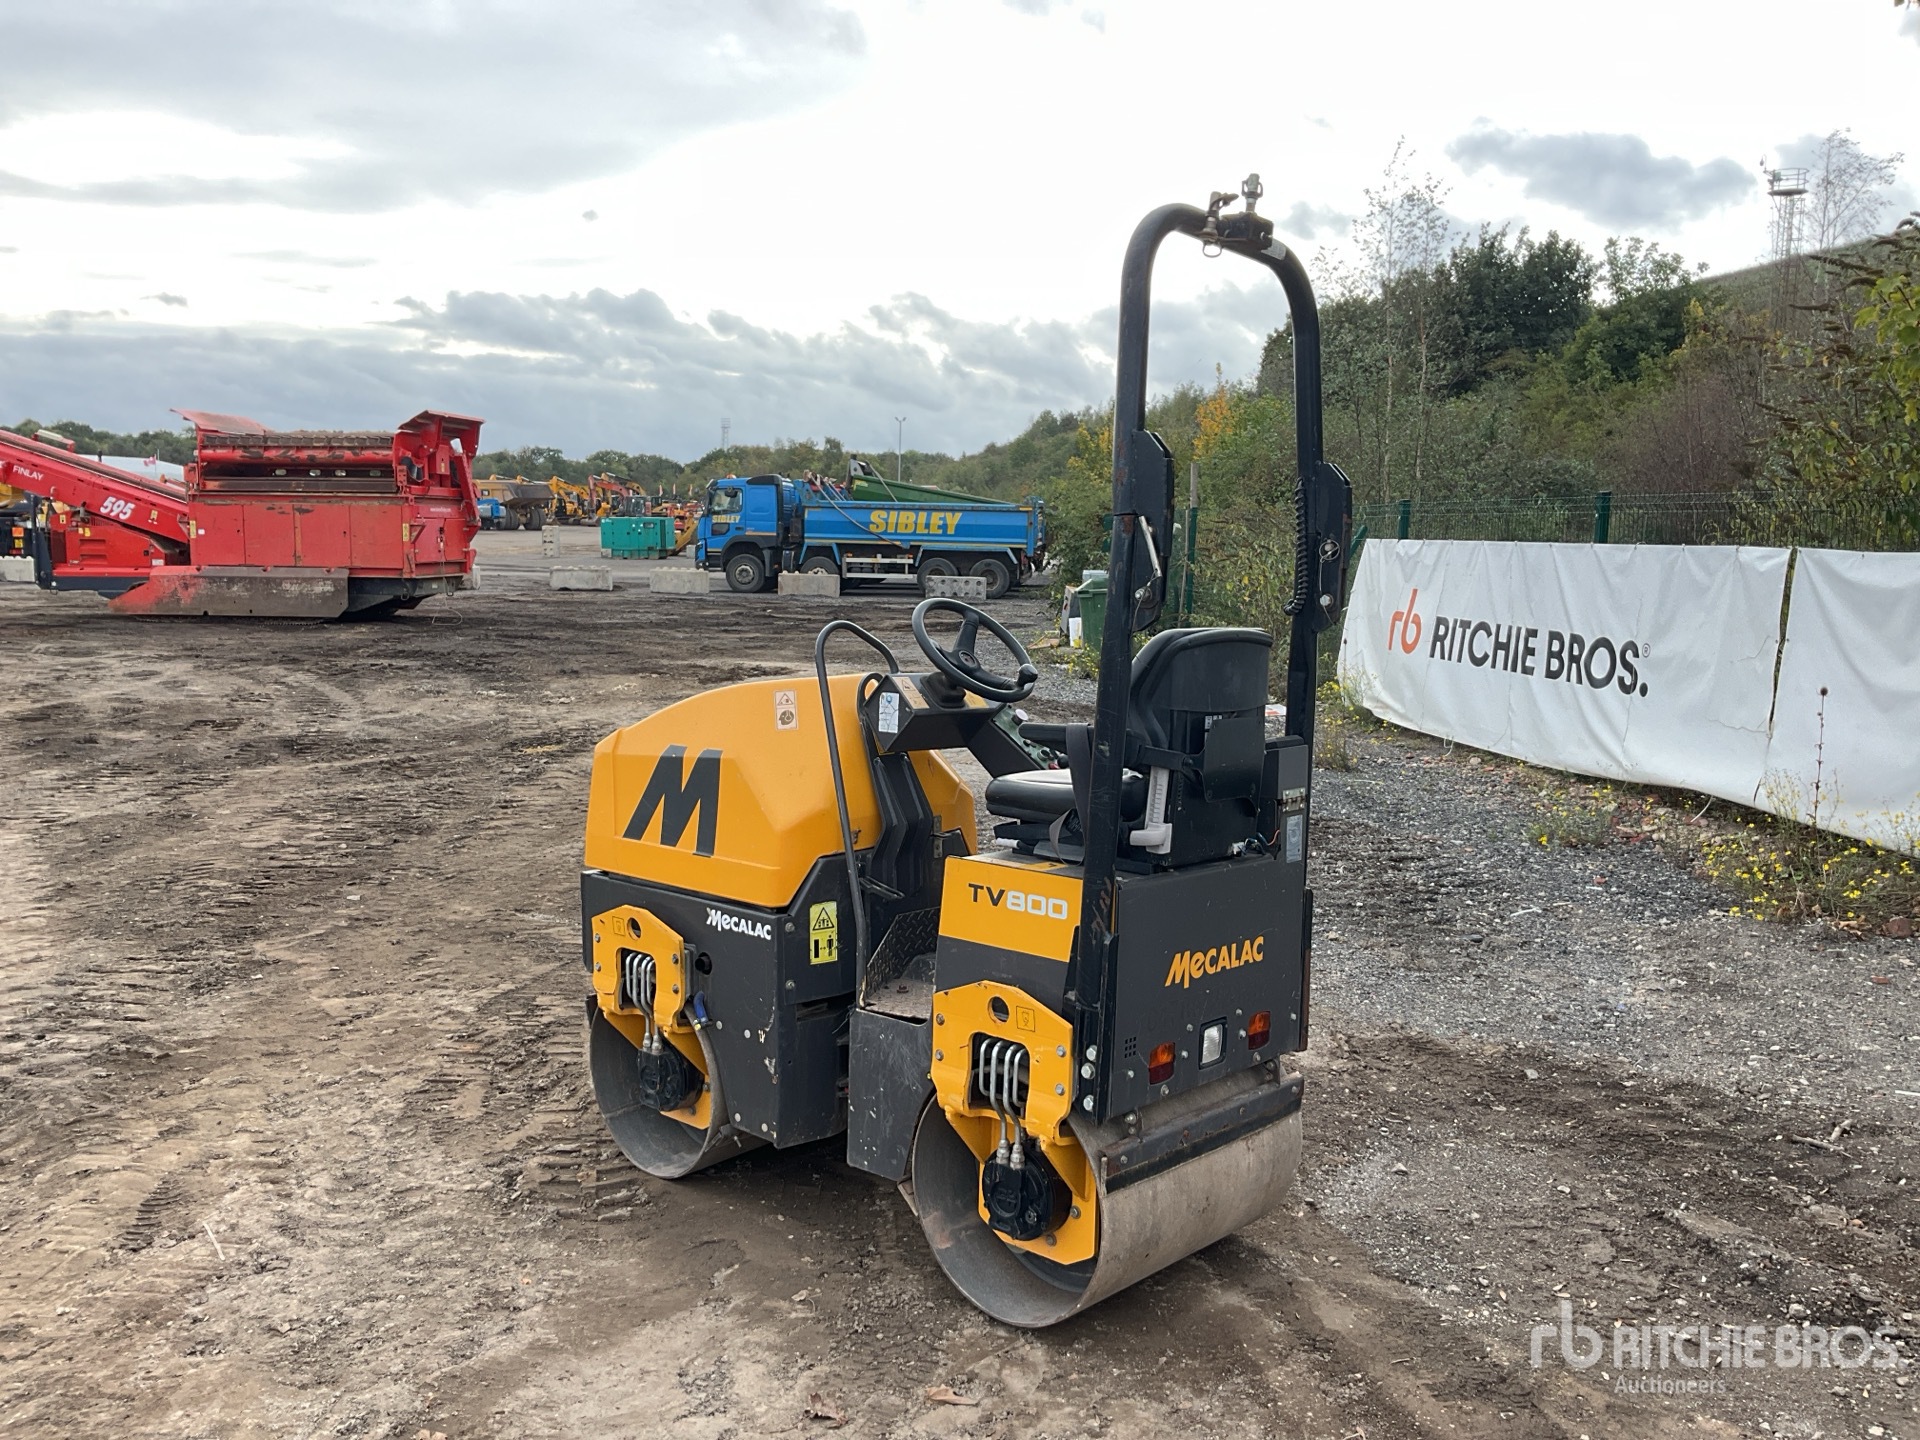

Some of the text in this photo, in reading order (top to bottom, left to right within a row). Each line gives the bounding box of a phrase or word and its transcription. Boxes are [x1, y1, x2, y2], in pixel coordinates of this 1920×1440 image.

[12, 465, 44, 481] FINLAY
[100, 496, 136, 520] 595
[869, 509, 963, 535] SIBLEY
[1388, 588, 1422, 654] rb
[1429, 616, 1539, 676] RITCHIE
[968, 882, 1068, 920] TV800
